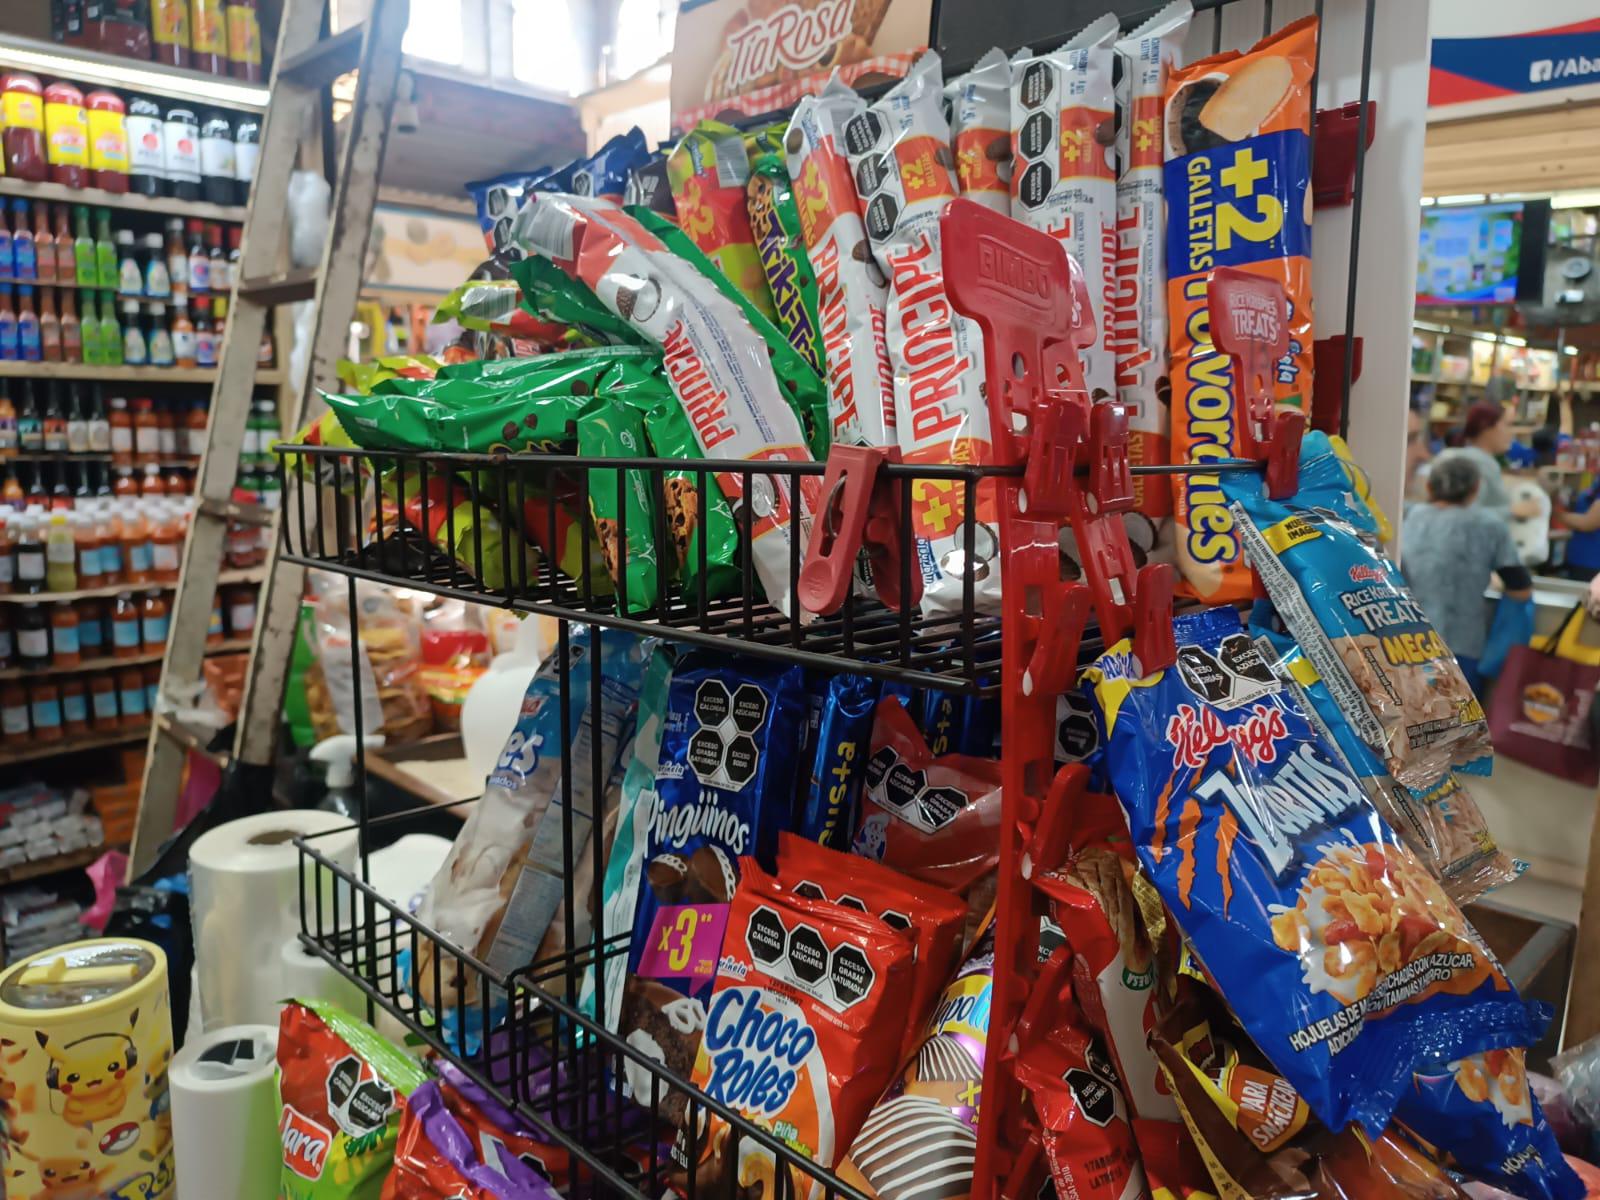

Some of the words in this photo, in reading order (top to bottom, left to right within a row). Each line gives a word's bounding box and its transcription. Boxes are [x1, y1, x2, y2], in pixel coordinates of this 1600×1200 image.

[1187, 155, 1213, 272] GALLETAS
[1216, 148, 1284, 251] +2
[1231, 308, 1279, 343] TREATS
[1341, 590, 1370, 610] RICE
[1353, 600, 1430, 632] TREATS
[1382, 629, 1449, 666] MEGA
[757, 923, 779, 940] EXCESO
[796, 942, 821, 959] EXCESO
[840, 956, 866, 974] EXCESO
[838, 966, 864, 984] GRASAS
[704, 988, 816, 1063] Choco
[1288, 1010, 1349, 1053] HOJUELAS
[1345, 1004, 1362, 1023] DE
[706, 1049, 799, 1115] Roles
